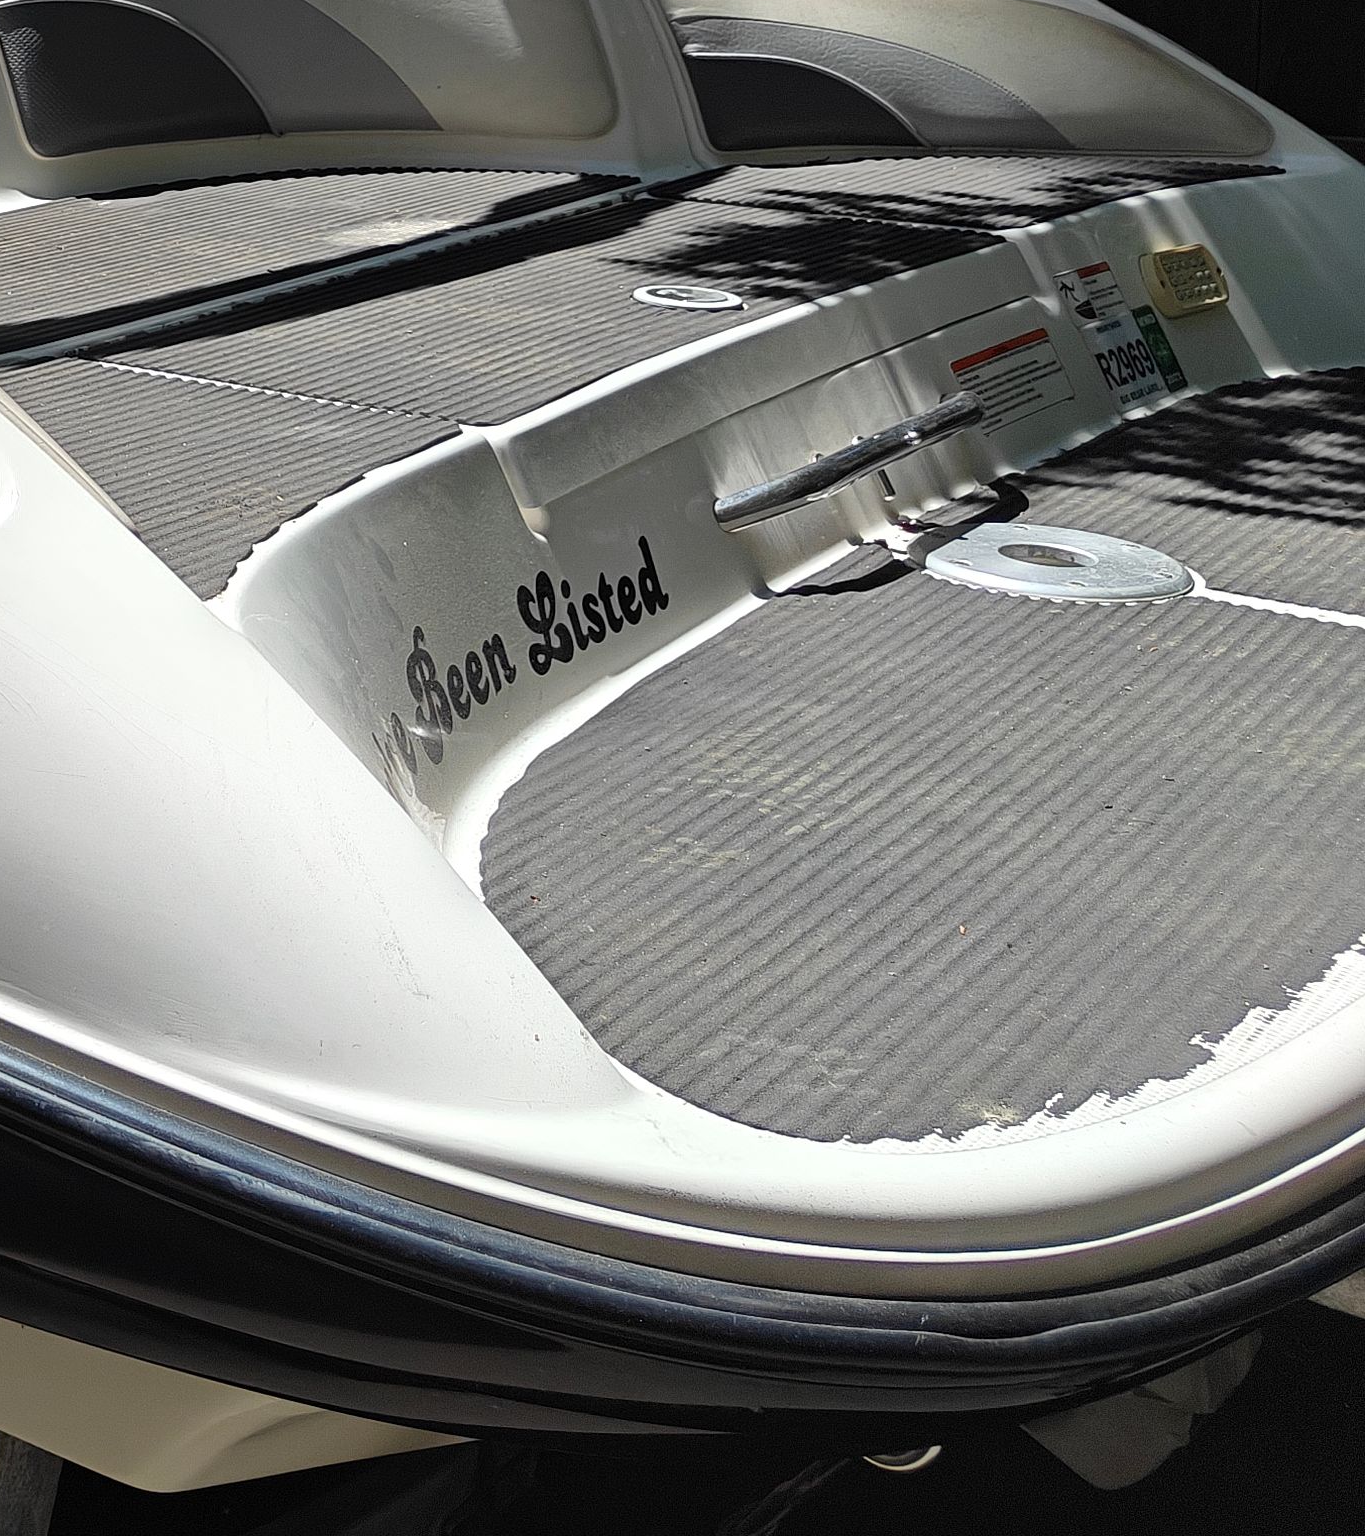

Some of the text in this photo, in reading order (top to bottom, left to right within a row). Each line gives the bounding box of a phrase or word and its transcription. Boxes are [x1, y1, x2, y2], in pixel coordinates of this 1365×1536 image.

[1094, 338, 1156, 390] R2969
[406, 625, 517, 764] Been
[516, 535, 669, 676] Listed
